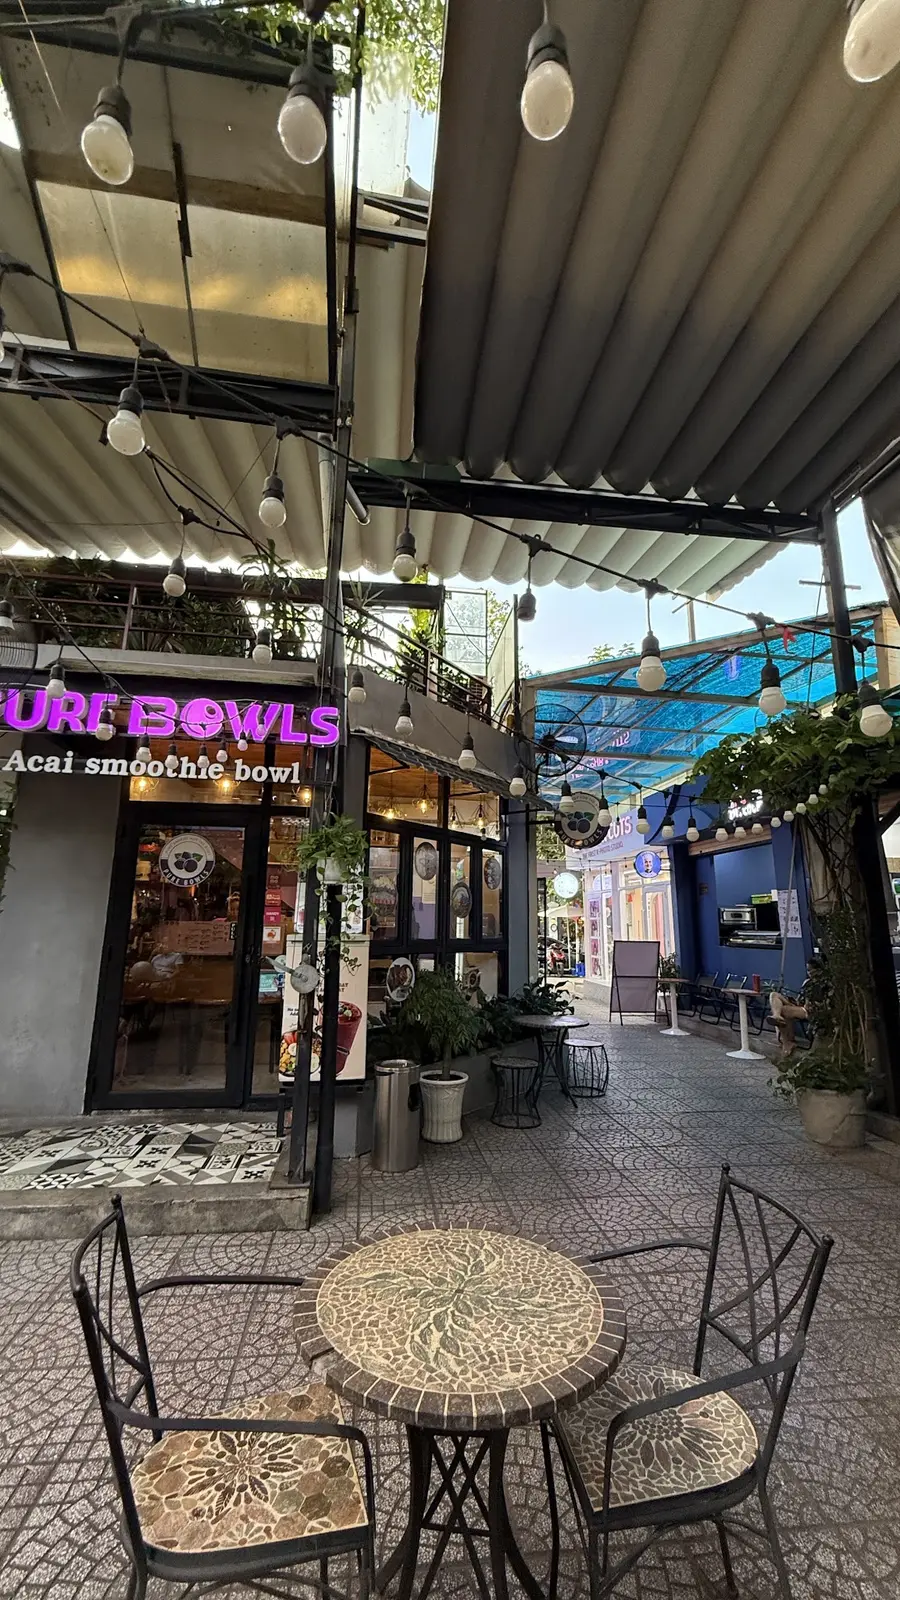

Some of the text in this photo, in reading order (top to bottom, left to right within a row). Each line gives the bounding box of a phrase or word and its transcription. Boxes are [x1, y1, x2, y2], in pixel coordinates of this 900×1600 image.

[0, 688, 340, 746] URE BOWLS
[2, 749, 74, 774] Acai
[234, 758, 301, 784] bowl
[163, 868, 209, 886] PURE BOWLS
